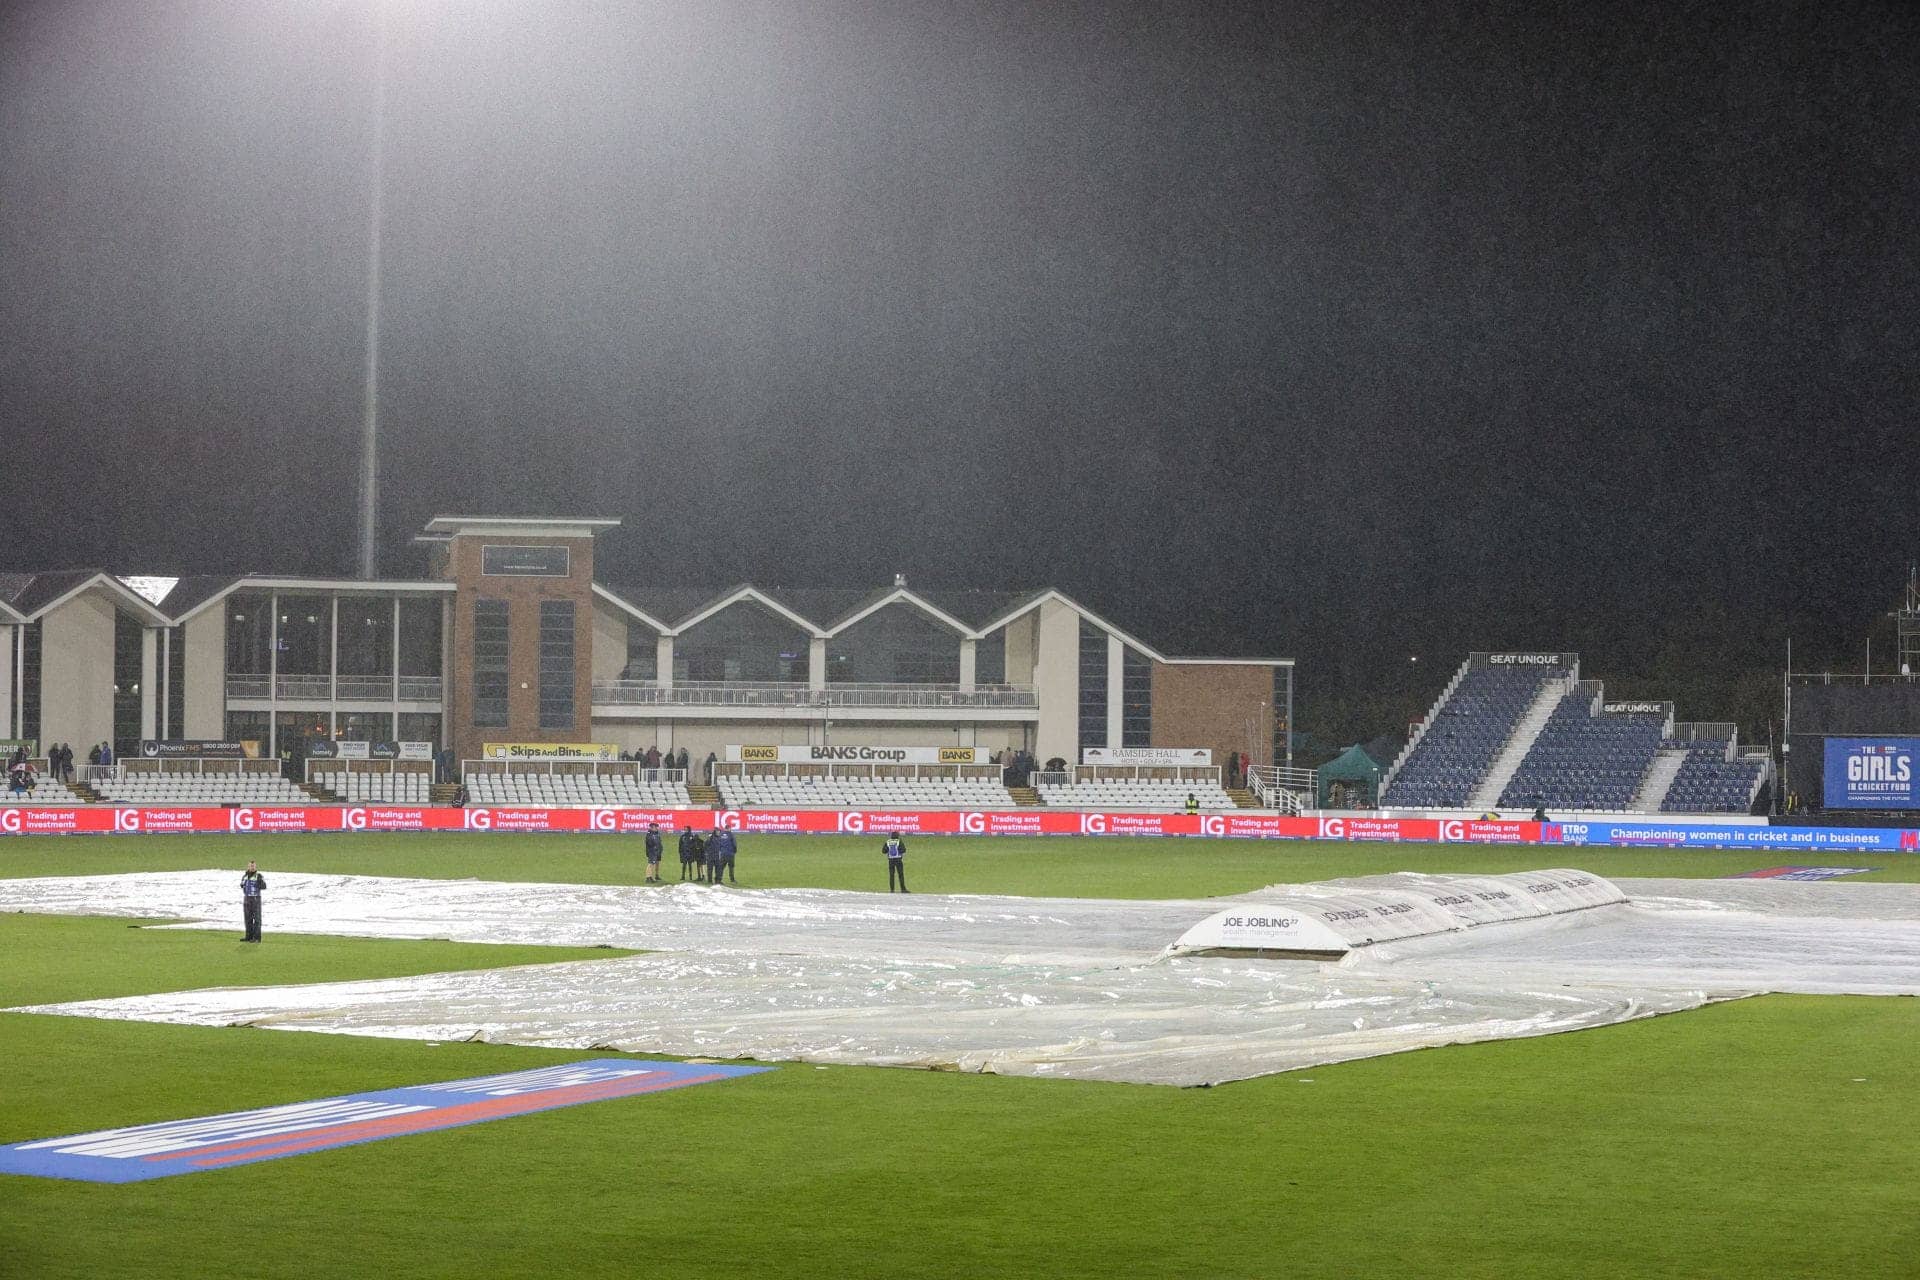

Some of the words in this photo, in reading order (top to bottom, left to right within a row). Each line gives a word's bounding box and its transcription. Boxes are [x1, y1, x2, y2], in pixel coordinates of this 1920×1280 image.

[1490, 655, 1516, 664] SEAT
[1518, 655, 1559, 665] UNIQUE
[1604, 704, 1627, 713] SEAT
[1627, 704, 1661, 713] UNIQUE
[744, 750, 774, 758] BANKS
[811, 746, 857, 760] BANKS
[859, 747, 906, 762] Group
[941, 751, 972, 760] BANKS
[1112, 750, 1154, 758] RAMSIDE
[1157, 750, 1181, 758] HALL
[1848, 756, 1911, 782] GIRLS
[1858, 783, 1889, 791] CRICKET
[0, 809, 21, 831] G
[27, 812, 58, 820] Trading
[114, 809, 139, 831] IG
[145, 812, 175, 820] Trading
[229, 808, 254, 831] IG
[260, 812, 288, 820] Trading
[341, 808, 366, 830] IG
[373, 812, 403, 820] Trading
[464, 808, 491, 830] IG
[498, 812, 529, 821] Trading
[531, 812, 548, 820] and
[590, 809, 616, 831] IG
[623, 813, 654, 822] Trading
[747, 814, 778, 823] Trading
[780, 814, 797, 822] and
[870, 815, 901, 824] Trading
[991, 816, 1022, 824] Trading
[714, 811, 740, 831] IG
[837, 812, 864, 833] IG
[959, 812, 985, 834] IG
[1080, 813, 1106, 835] IG
[1112, 817, 1143, 826] Trading
[1231, 819, 1262, 828] Trading
[1350, 821, 1381, 830] Trading
[1200, 815, 1225, 837] IG
[1318, 818, 1344, 839] IG
[1438, 820, 1465, 841] IG
[1471, 824, 1501, 833] Trading
[1503, 824, 1519, 832] and
[1564, 834, 1589, 842] BANK
[1611, 828, 1686, 841] Championing
[1690, 831, 1731, 840] women
[1734, 830, 1744, 841] in
[1748, 831, 1788, 841] cricket
[1791, 832, 1813, 842] and
[1816, 832, 1826, 842] in
[1830, 832, 1880, 844] business
[1223, 918, 1243, 926] JOE
[1246, 918, 1290, 928] JOBLING
